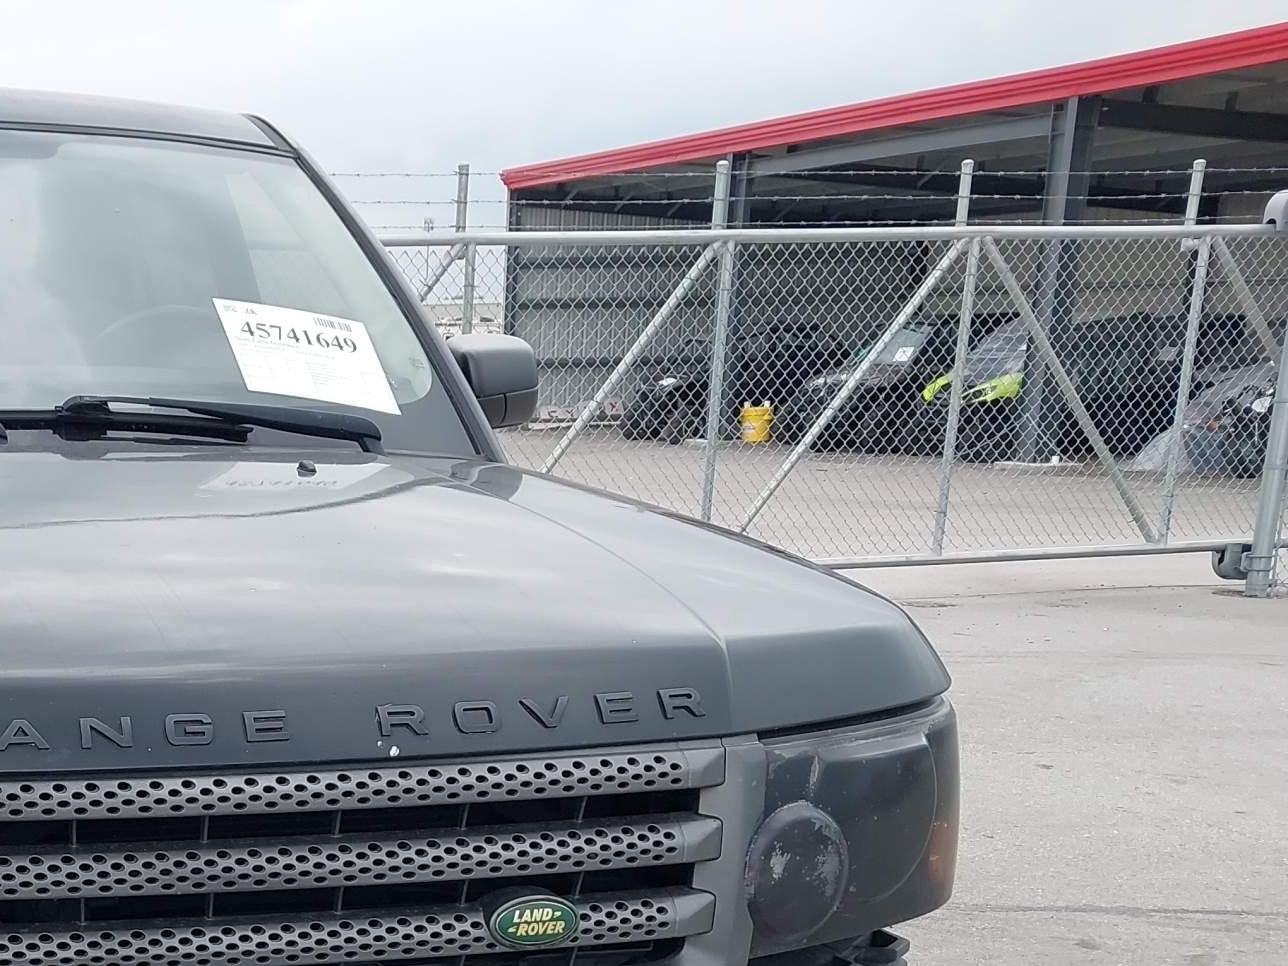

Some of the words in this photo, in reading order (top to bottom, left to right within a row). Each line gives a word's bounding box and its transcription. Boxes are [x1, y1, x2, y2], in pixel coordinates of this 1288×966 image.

[241, 321, 358, 353] 45741649
[375, 687, 707, 737] ROVER
[513, 908, 553, 923] LAND
[516, 920, 566, 937] ROVER
